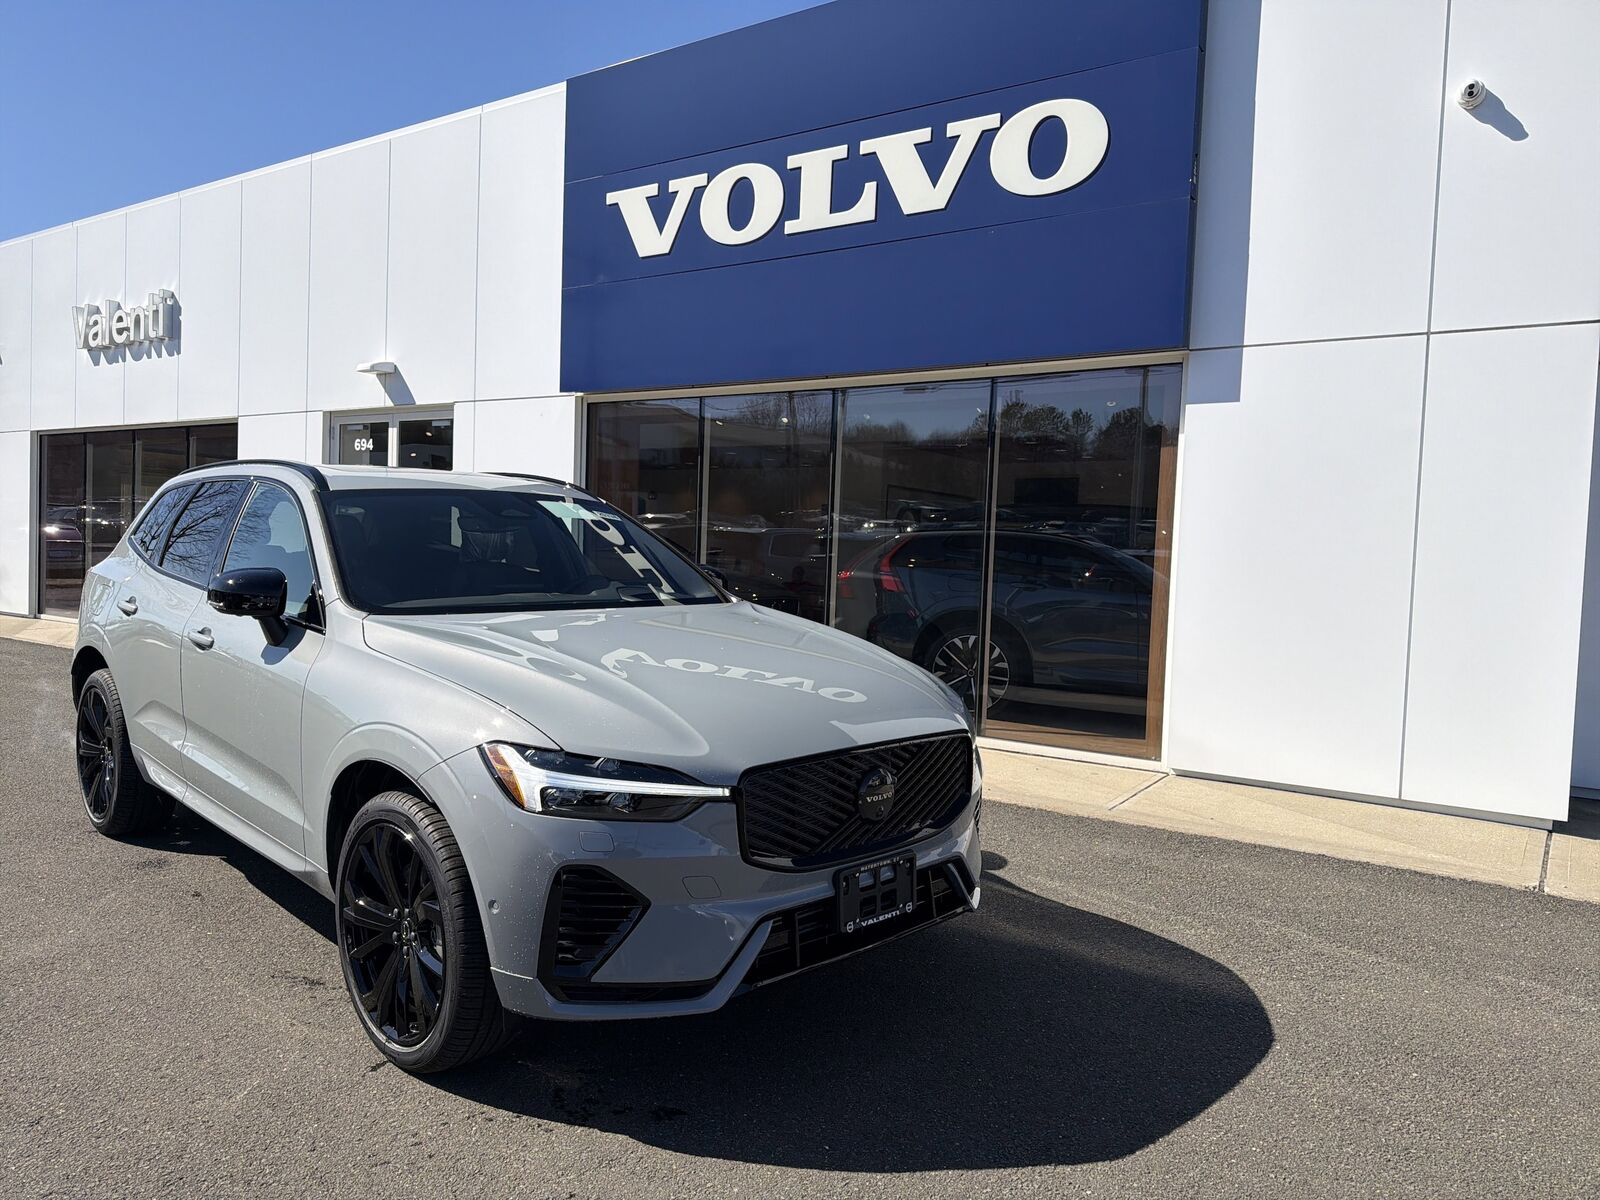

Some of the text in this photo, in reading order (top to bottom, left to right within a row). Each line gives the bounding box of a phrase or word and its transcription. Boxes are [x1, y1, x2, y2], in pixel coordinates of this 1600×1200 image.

[606, 98, 1110, 258] VOLVO
[72, 288, 173, 349] Valenti
[354, 438, 374, 451] 694
[866, 791, 893, 803] VOLVO
[861, 909, 900, 927] VALENTI
